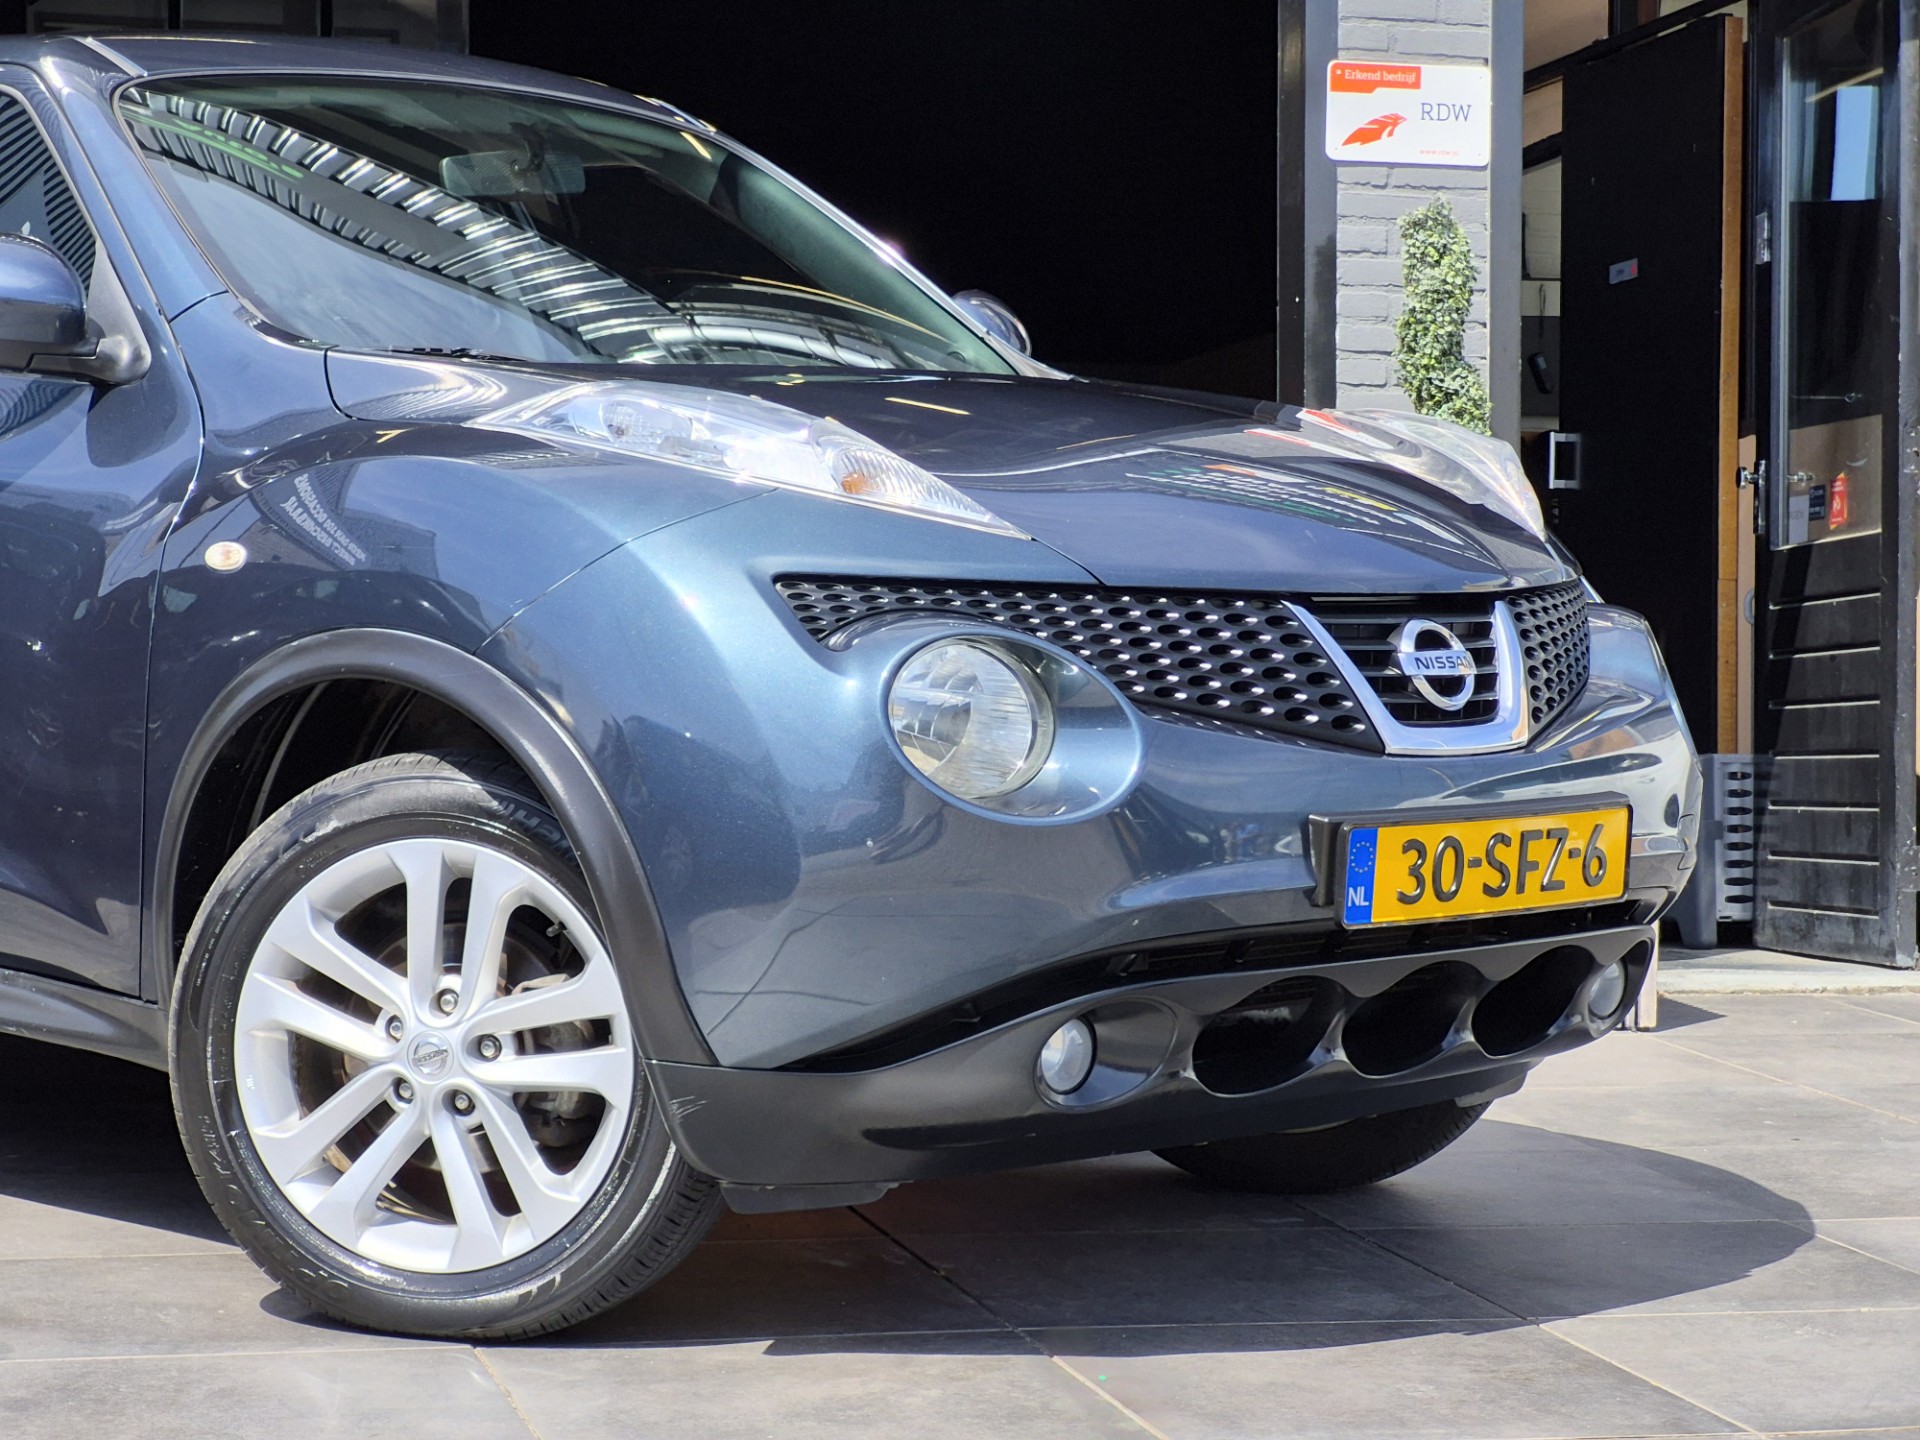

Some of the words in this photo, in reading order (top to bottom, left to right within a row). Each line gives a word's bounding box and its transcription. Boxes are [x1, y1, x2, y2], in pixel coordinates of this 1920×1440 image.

[1344, 69, 1380, 81] Erkend
[1383, 70, 1417, 84] bedrijf
[1420, 102, 1472, 122] RDW
[1414, 655, 1474, 670] NISSAN
[1396, 823, 1608, 905] 30-SFZ-6
[1347, 886, 1370, 907] NL
